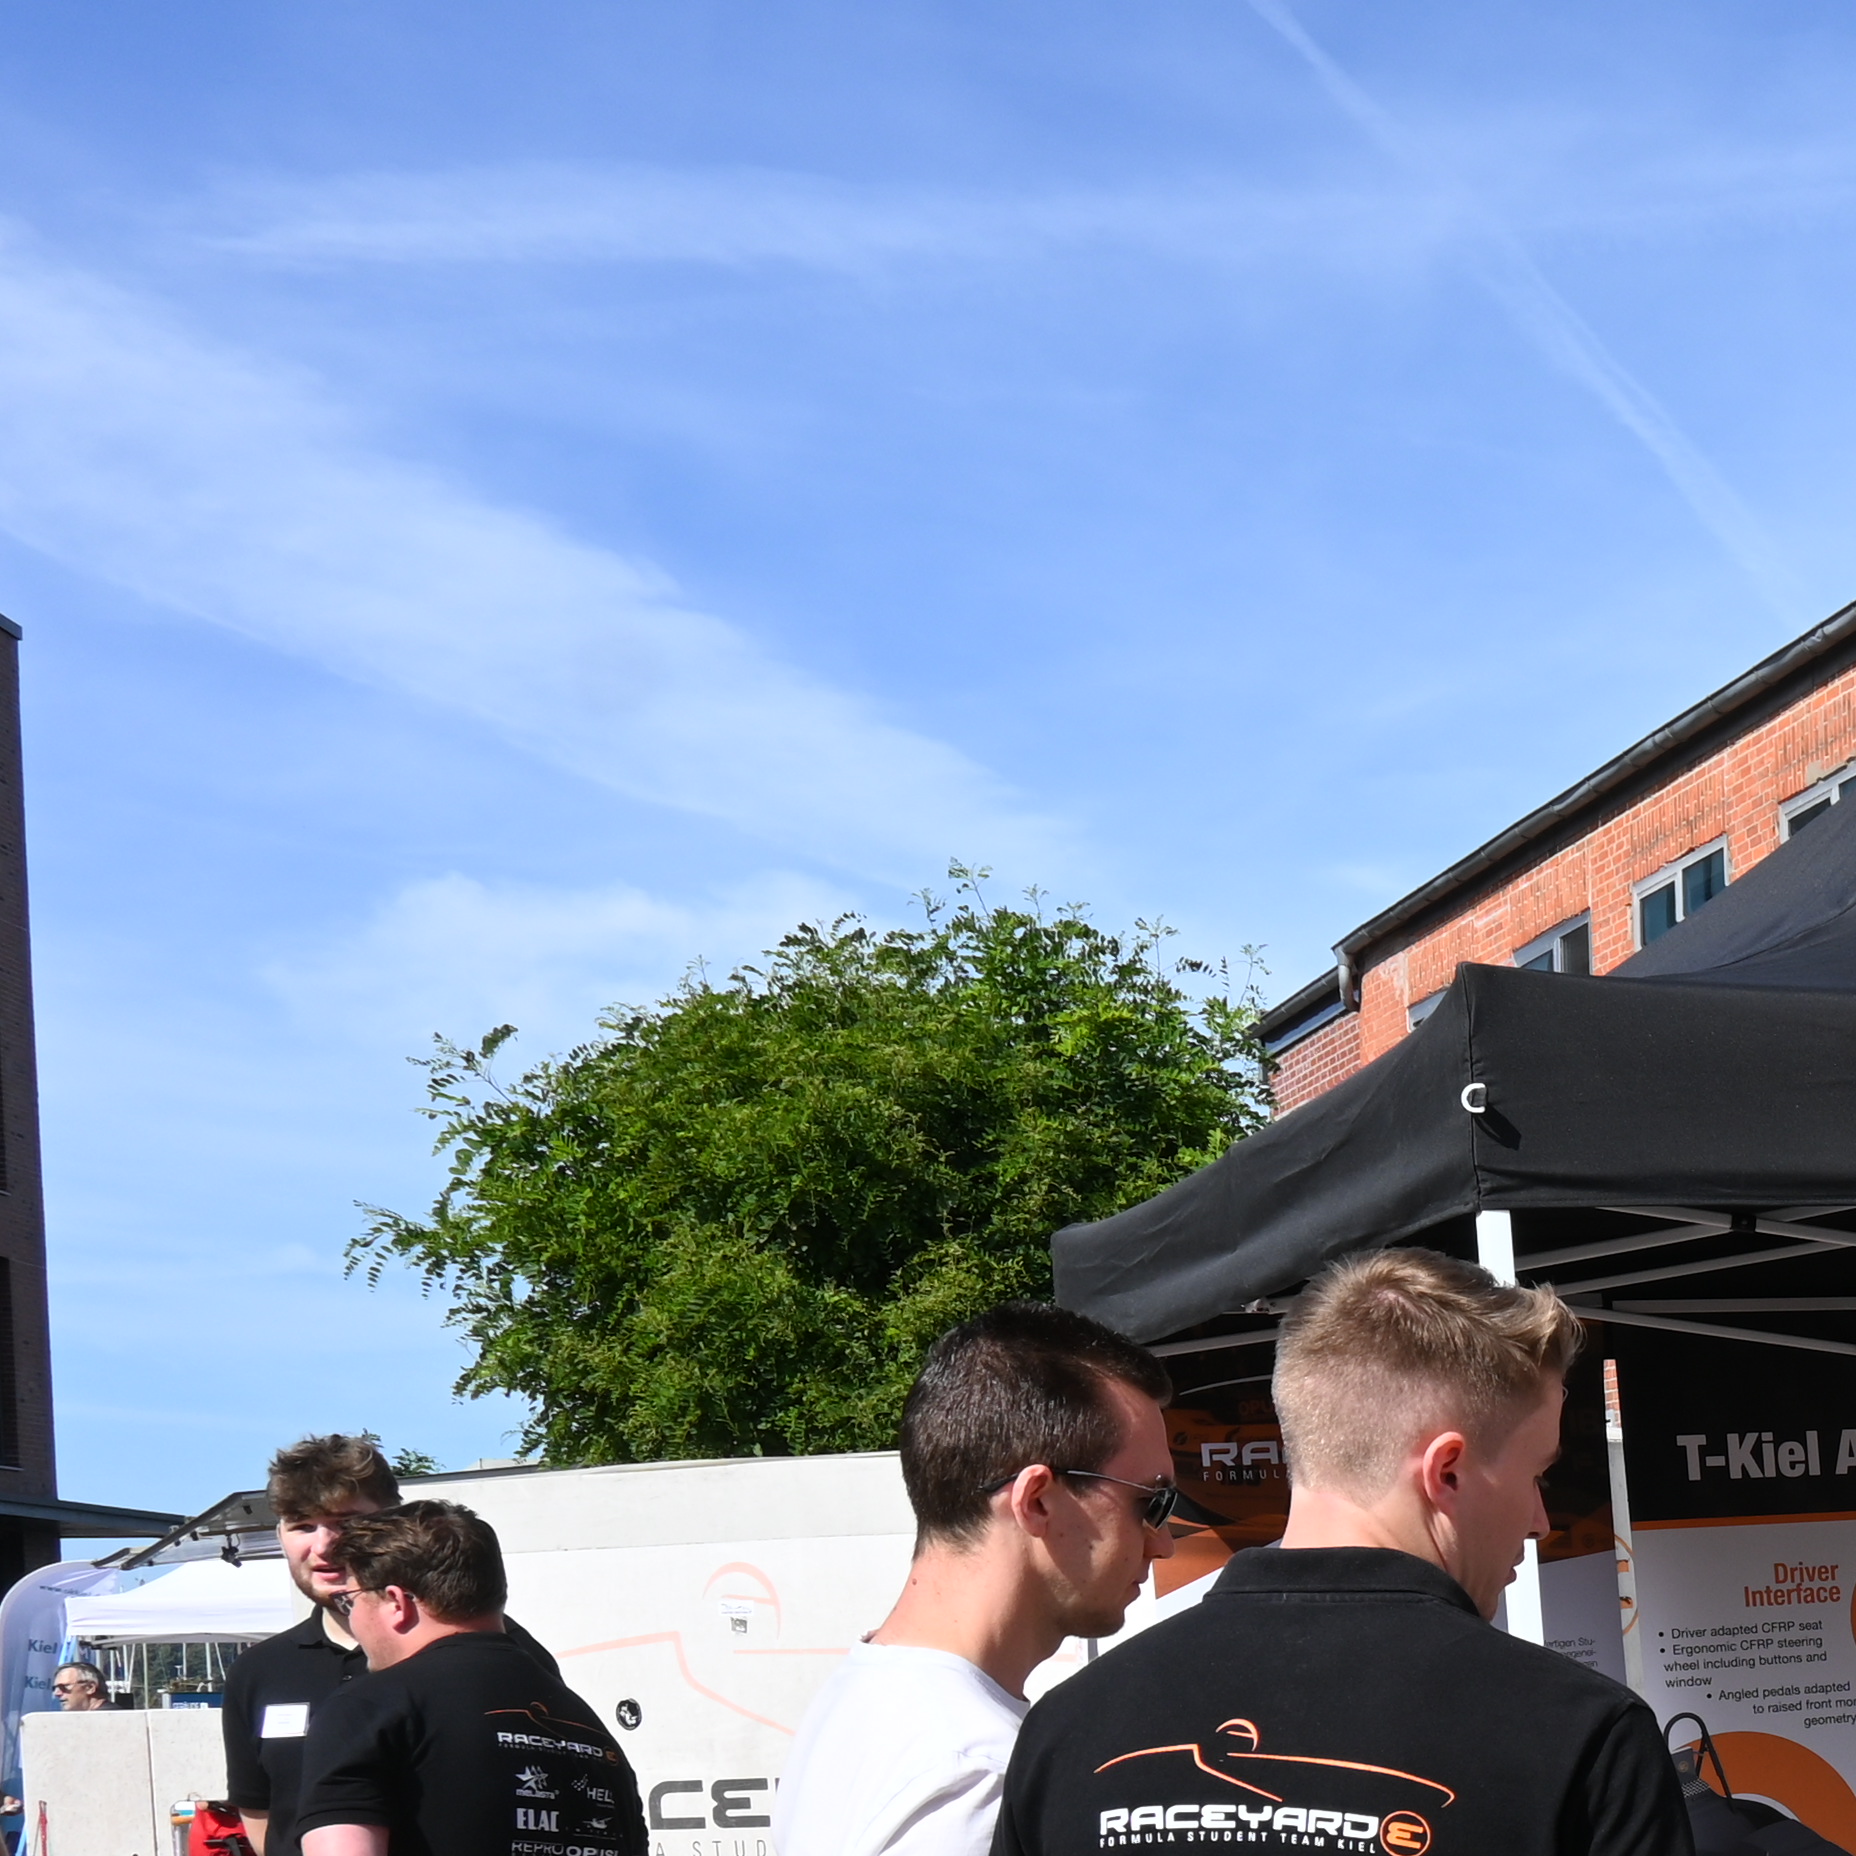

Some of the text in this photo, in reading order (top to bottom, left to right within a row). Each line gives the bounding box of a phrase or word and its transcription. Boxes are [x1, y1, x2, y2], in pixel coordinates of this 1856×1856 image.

[1676, 1430, 1821, 1481] T-Kiel
[1774, 1562, 1839, 1584] Driver
[1744, 1583, 1841, 1607] Interface
[1671, 1620, 1823, 1639] Driver adapted CFRP seat
[28, 1639, 58, 1654] Kiel
[1672, 1636, 1823, 1657] Ergonomic CFRP steering
[1664, 1650, 1827, 1673] wheel including buttons and
[1665, 1675, 1712, 1688] window
[1719, 1682, 1850, 1703] Angled pedals adapted
[1753, 1704, 1764, 1714] to
[1768, 1701, 1802, 1713] raised
[1806, 1699, 1831, 1711] front
[1804, 1713, 1856, 1728] geometry
[497, 1731, 603, 1757] RACEYARD
[516, 1808, 559, 1832] ELAC
[1100, 1804, 1379, 1839] RACEYARD
[1100, 1830, 1376, 1854] FORMULA STUDENT TEAM KIEL
